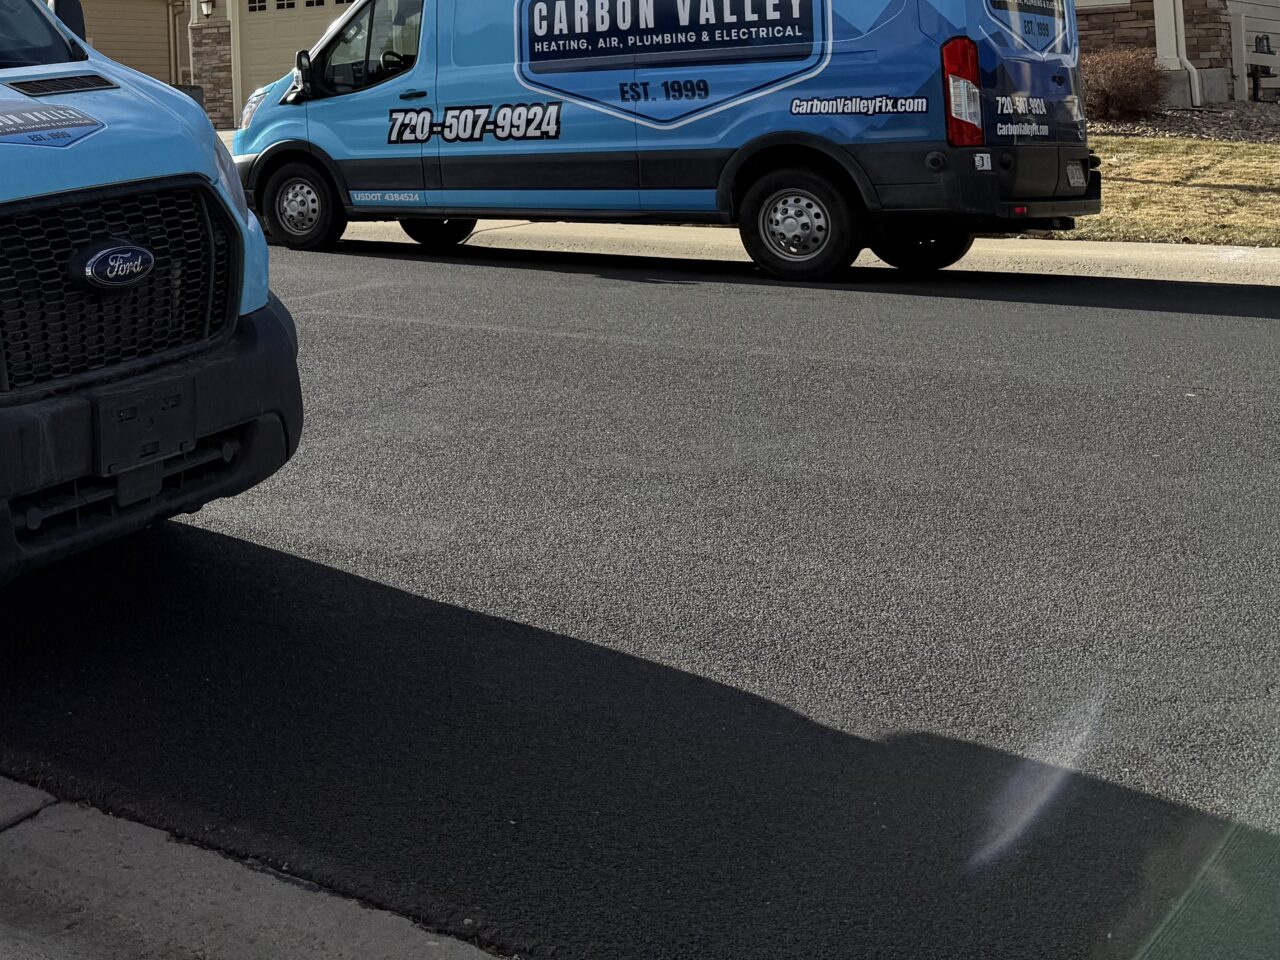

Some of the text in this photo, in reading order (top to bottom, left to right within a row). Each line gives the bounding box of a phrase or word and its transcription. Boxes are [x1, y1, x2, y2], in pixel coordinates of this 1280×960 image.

[534, 25, 802, 53] HEATING, AIR, PLUMBING & ELECTRICAL
[619, 79, 710, 103] EST. 1999
[23, 109, 83, 122] VALLEY
[791, 96, 927, 116] CarbonValleyFix.com
[996, 97, 1047, 115] 720-507-9924
[390, 105, 559, 141] 720-507-9924
[354, 193, 419, 202] USDOT 4384524
[106, 252, 142, 279] Ford
